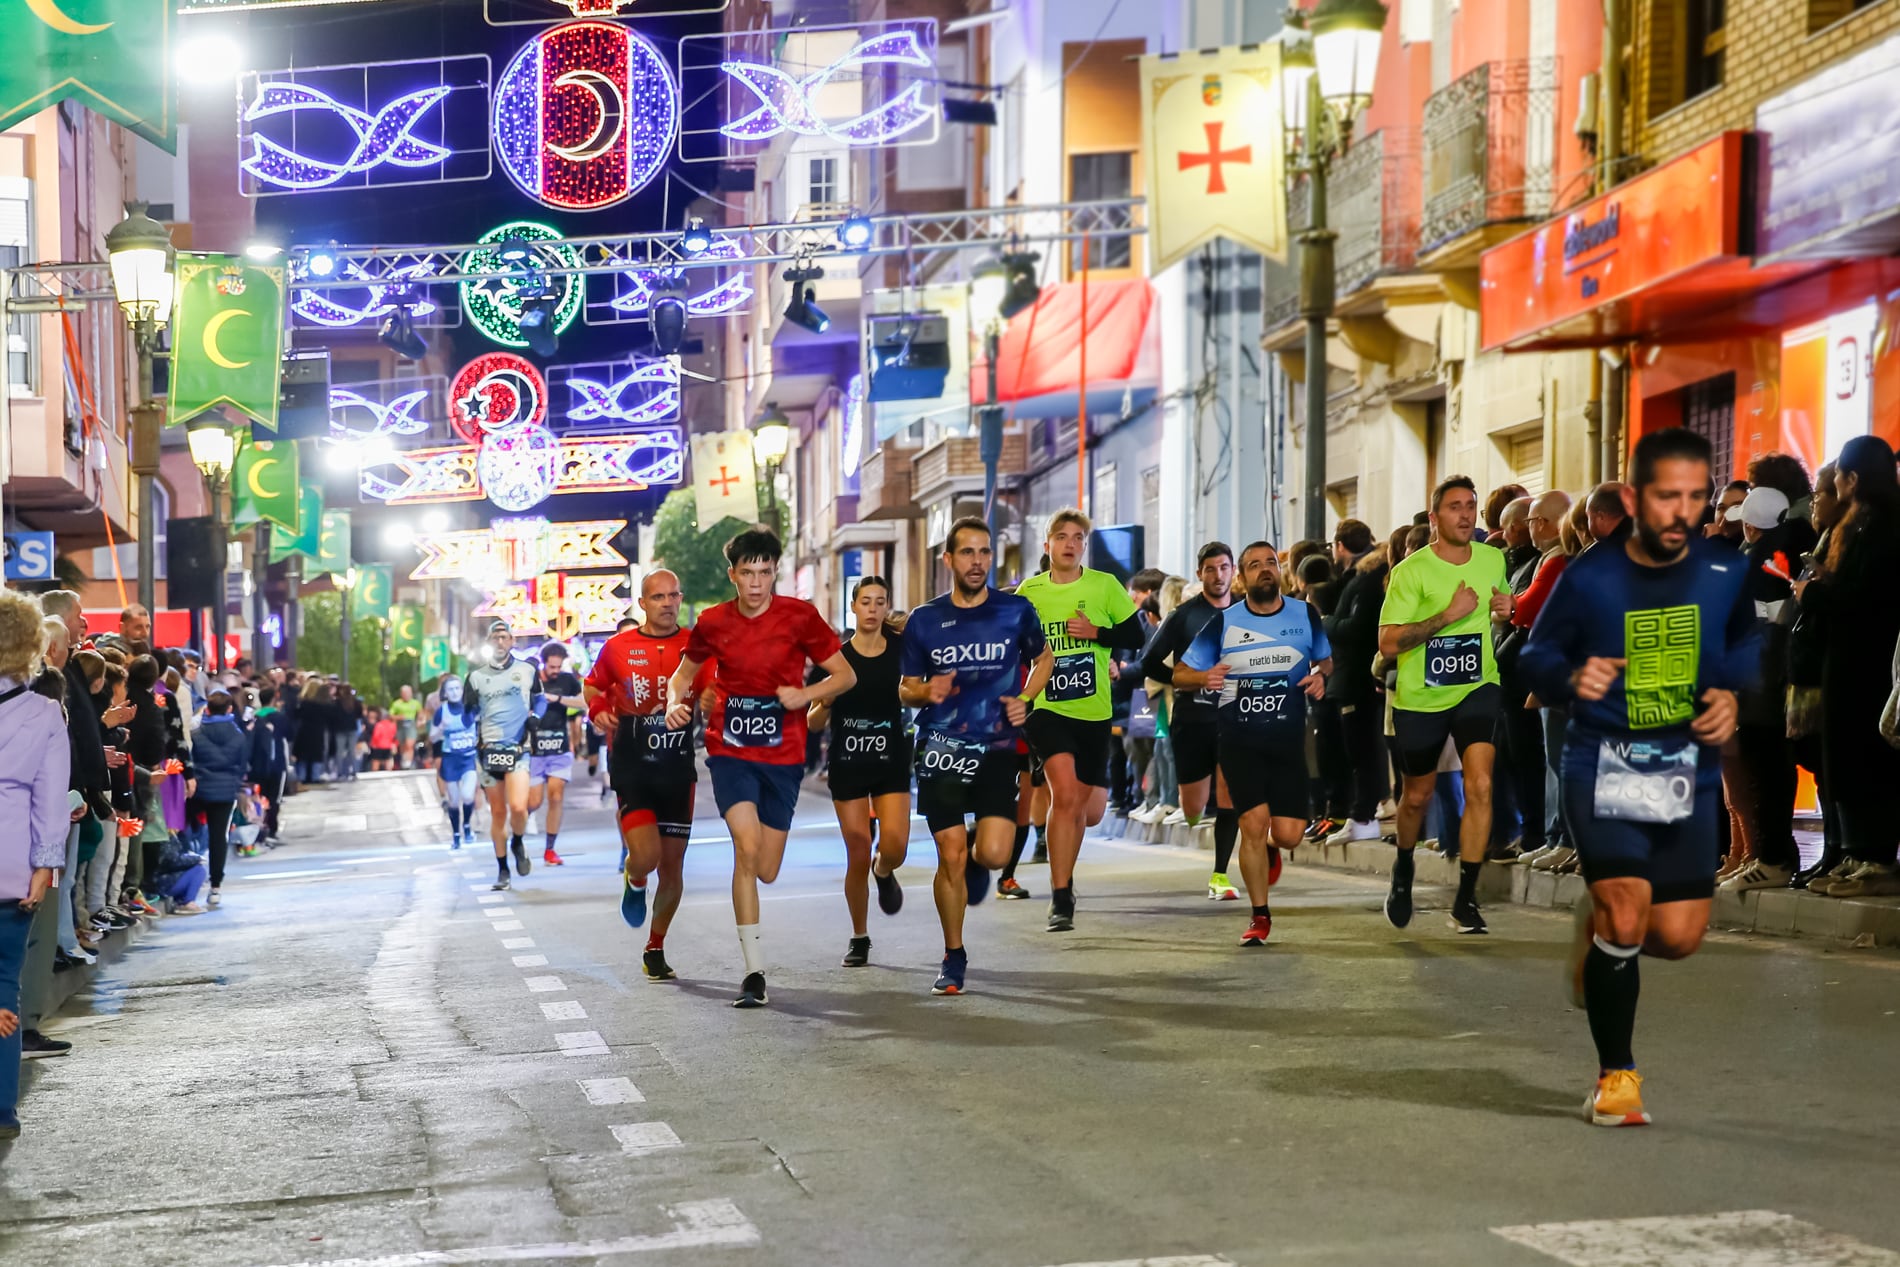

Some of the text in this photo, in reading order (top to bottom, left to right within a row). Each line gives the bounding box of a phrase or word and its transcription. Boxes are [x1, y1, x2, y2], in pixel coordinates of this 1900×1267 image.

[1040, 621, 1067, 637] LETI
[930, 642, 1006, 665] saxun
[1431, 654, 1477, 674] 0918
[1049, 671, 1091, 691] 1043
[728, 697, 743, 708] XIV
[1240, 695, 1287, 713] 0587
[643, 715, 659, 726] XIV
[730, 716, 776, 735] 0123
[537, 739, 564, 751] 0997
[648, 731, 686, 750] 0177
[845, 735, 887, 752] 0179
[487, 753, 515, 766] 1293
[925, 750, 980, 775] 0042
